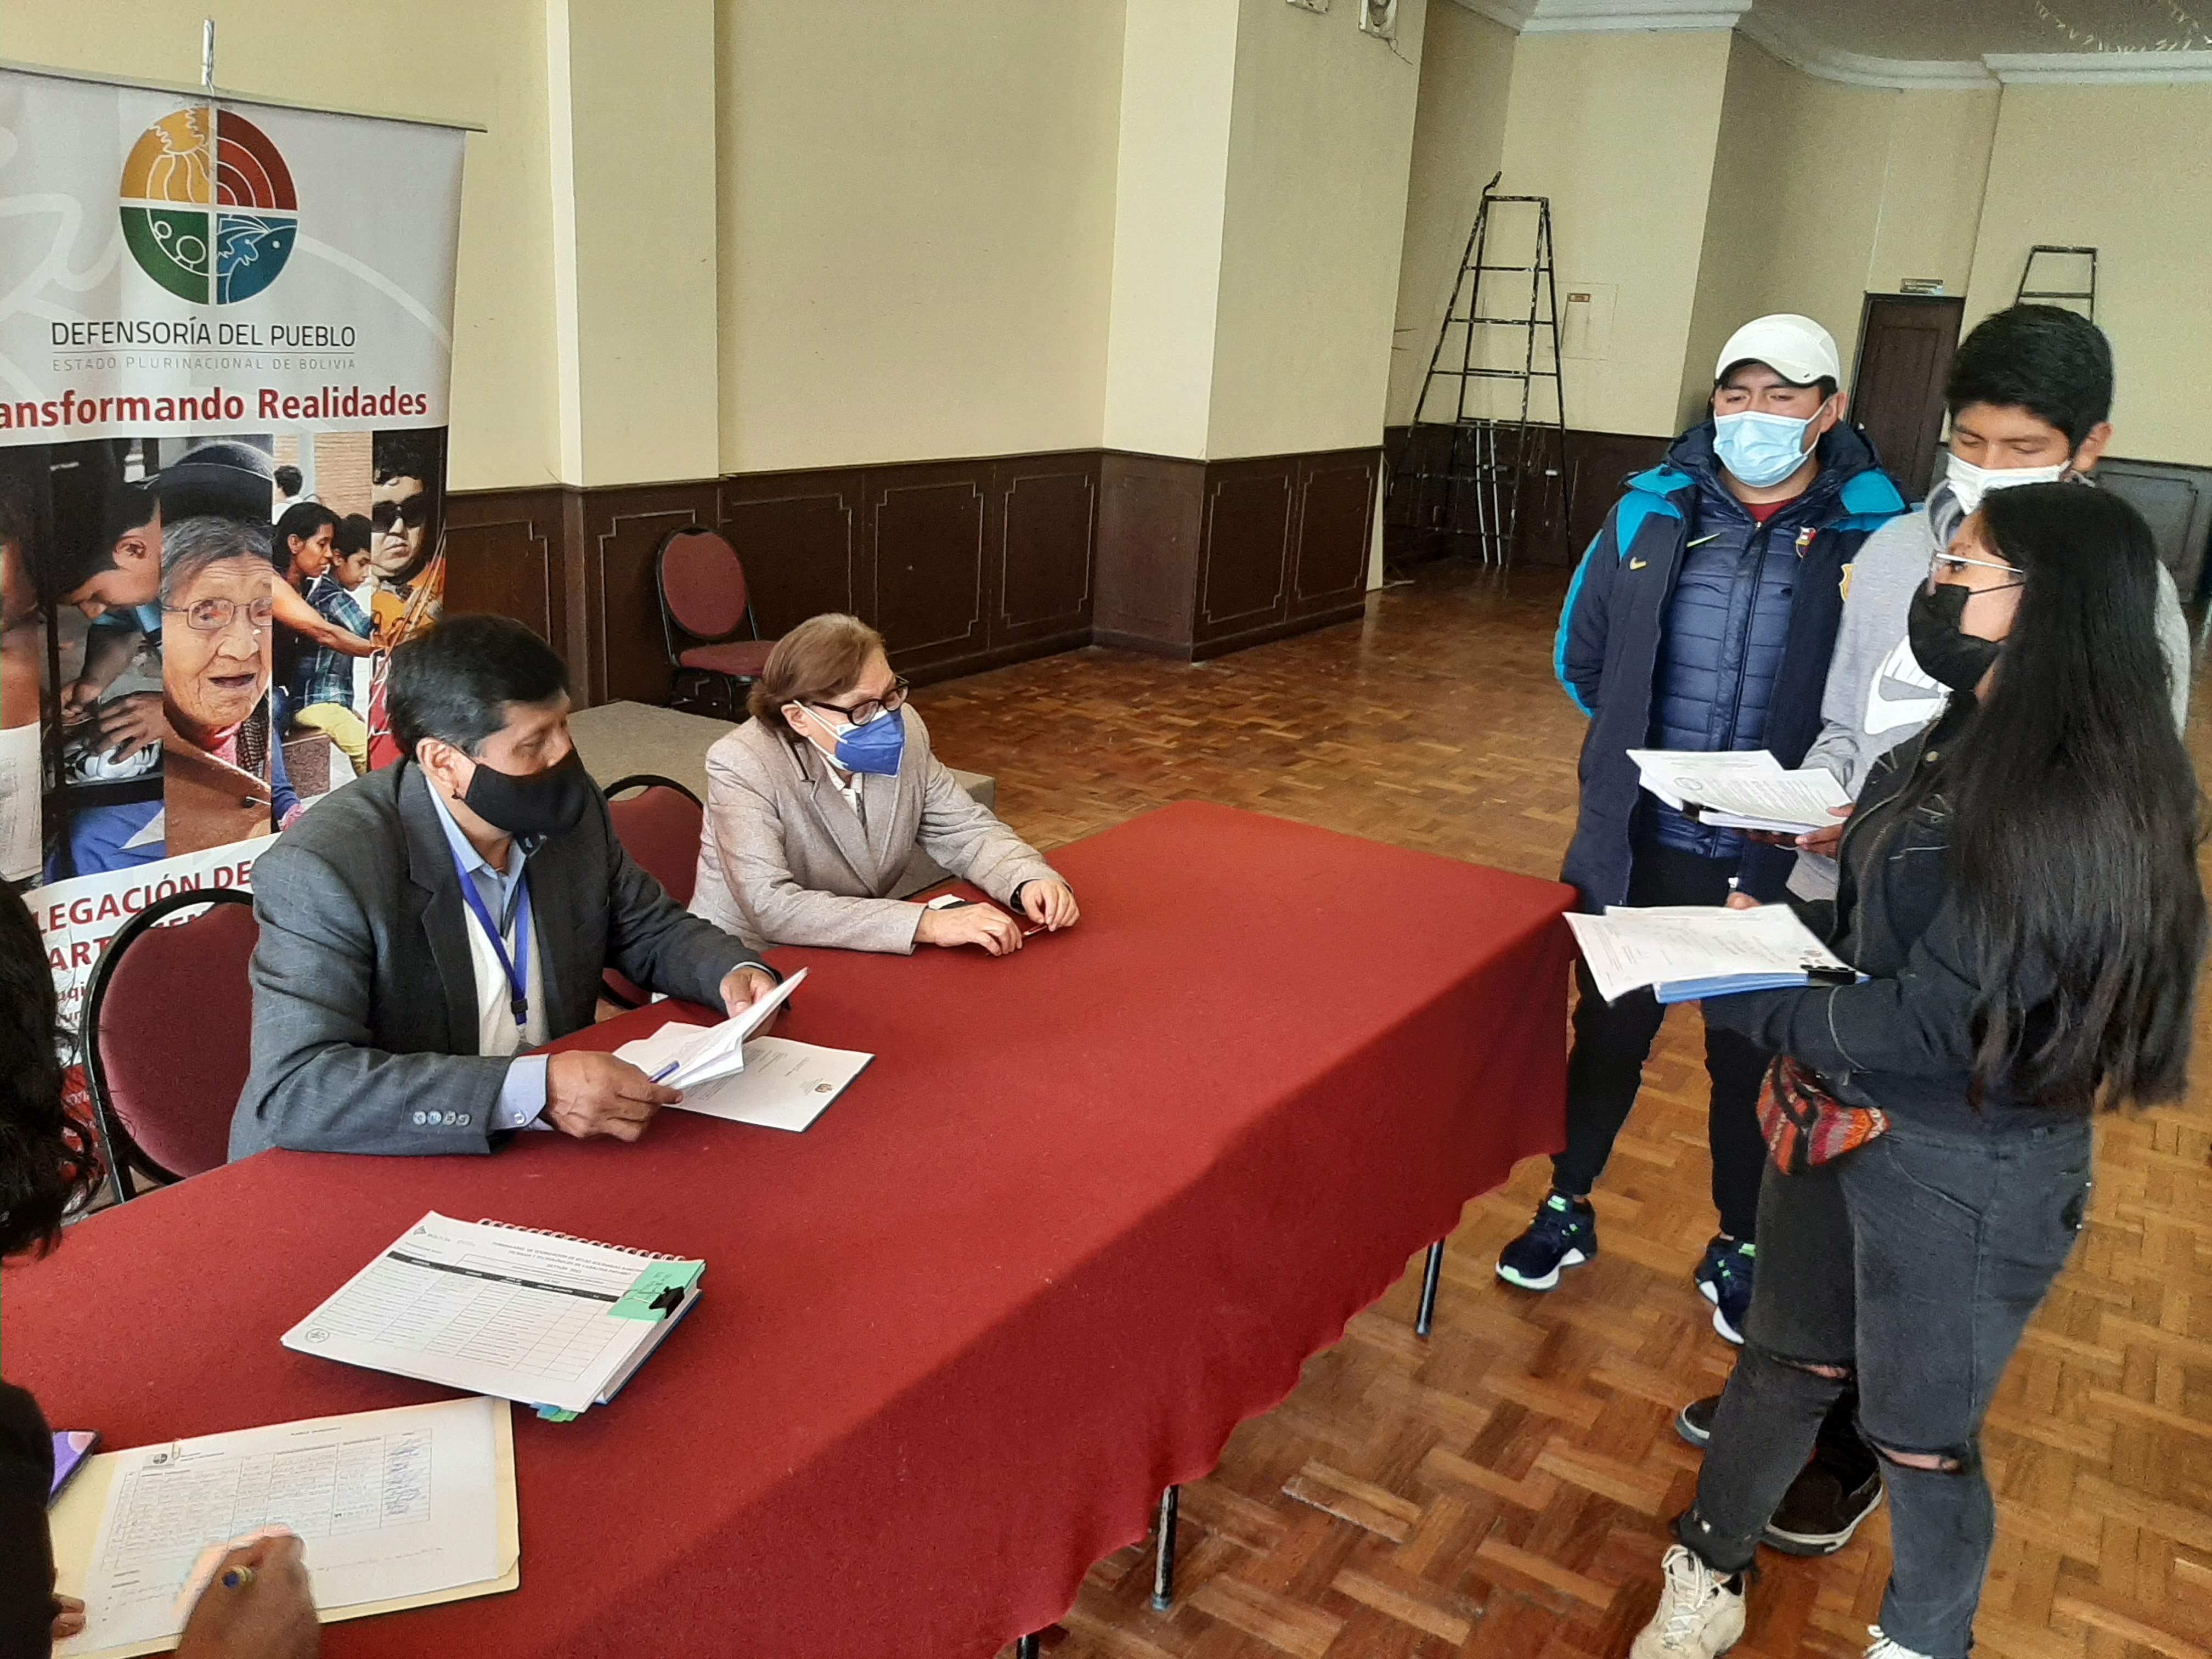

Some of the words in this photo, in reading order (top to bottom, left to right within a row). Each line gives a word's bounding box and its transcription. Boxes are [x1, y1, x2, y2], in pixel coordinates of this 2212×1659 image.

[52, 316, 212, 345] DEFENSORÍA
[219, 324, 263, 346] DEL
[271, 325, 356, 347] PUEBLO
[53, 357, 116, 371] ESTADO
[126, 357, 263, 370] PLURINACIONAL
[273, 359, 291, 369] DE
[299, 358, 355, 370] BOLIVIA
[258, 386, 427, 419] Realidades
